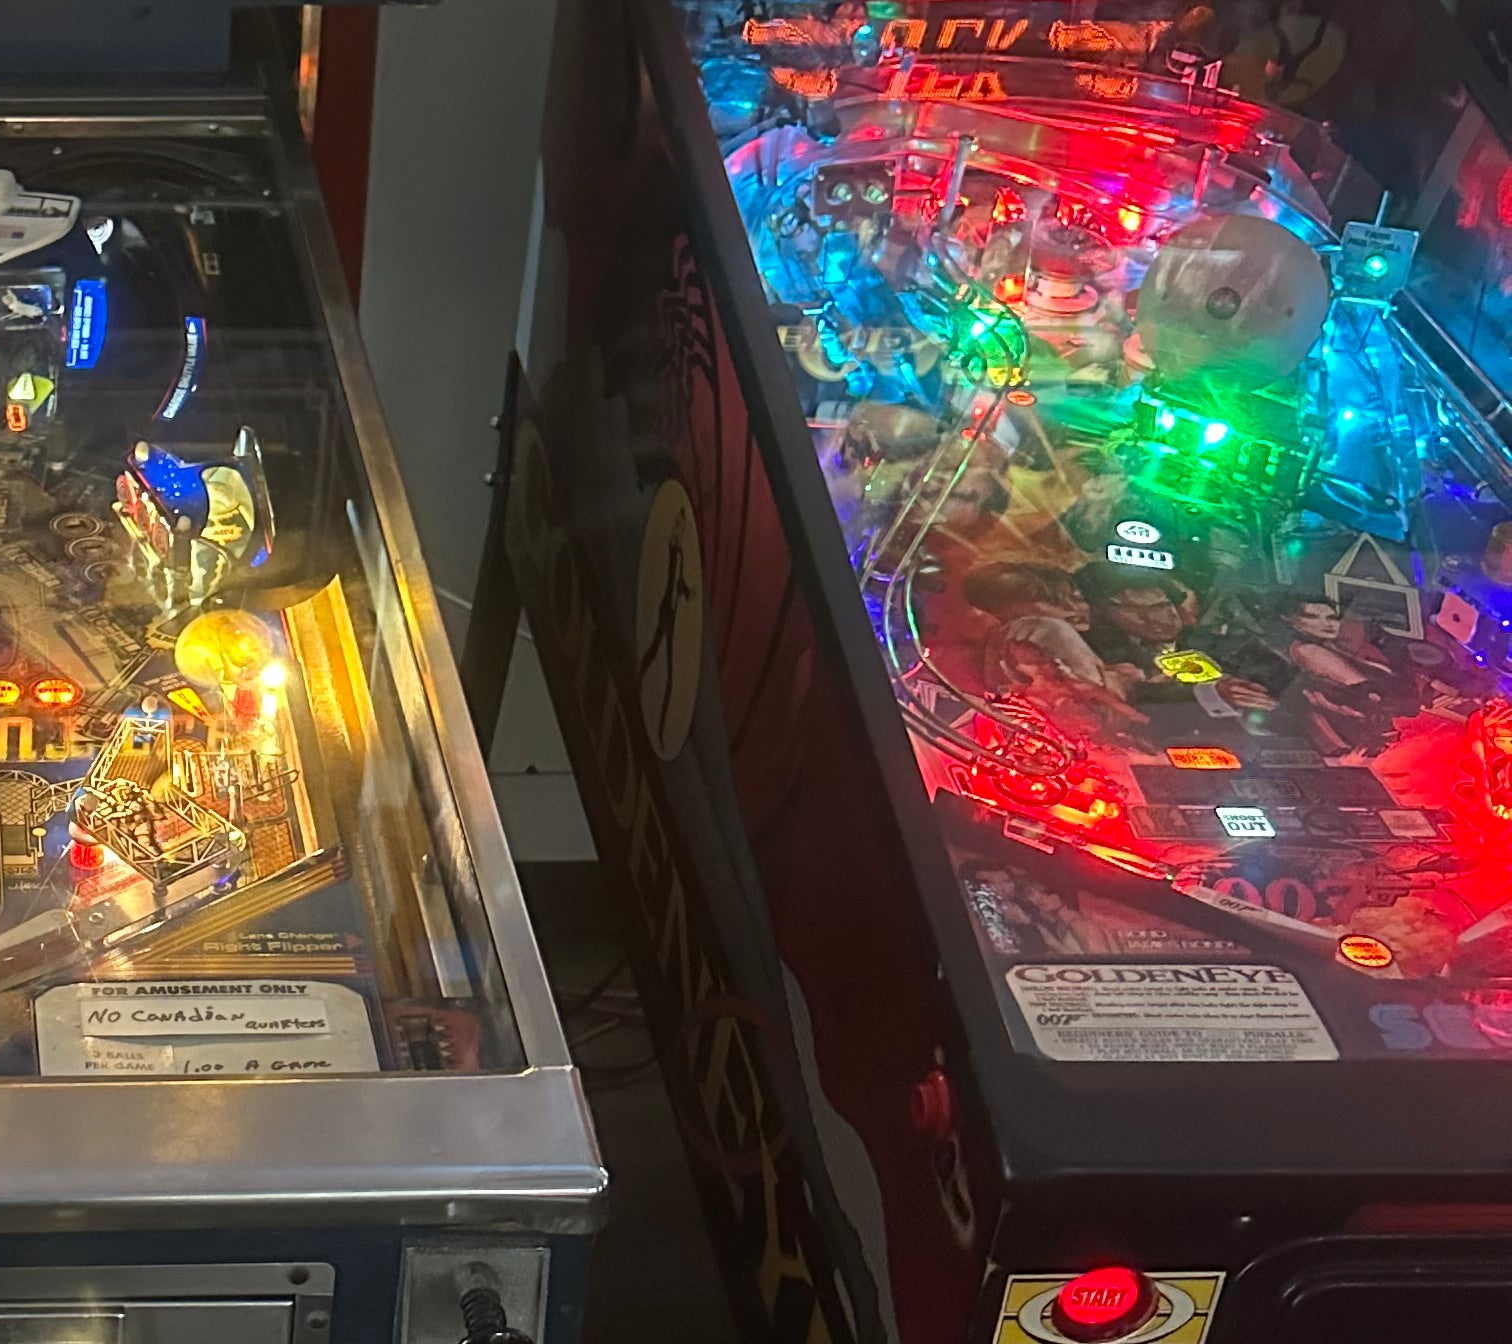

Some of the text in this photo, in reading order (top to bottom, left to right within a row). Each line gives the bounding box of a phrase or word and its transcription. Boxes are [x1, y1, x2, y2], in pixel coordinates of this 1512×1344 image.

[1227, 821, 1267, 831] OUT
[202, 941, 344, 953] Right Flipper
[90, 983, 309, 996] FOR AMUSEMENT ONLY
[87, 1007, 122, 1025] NO
[1070, 1286, 1129, 1309] START
